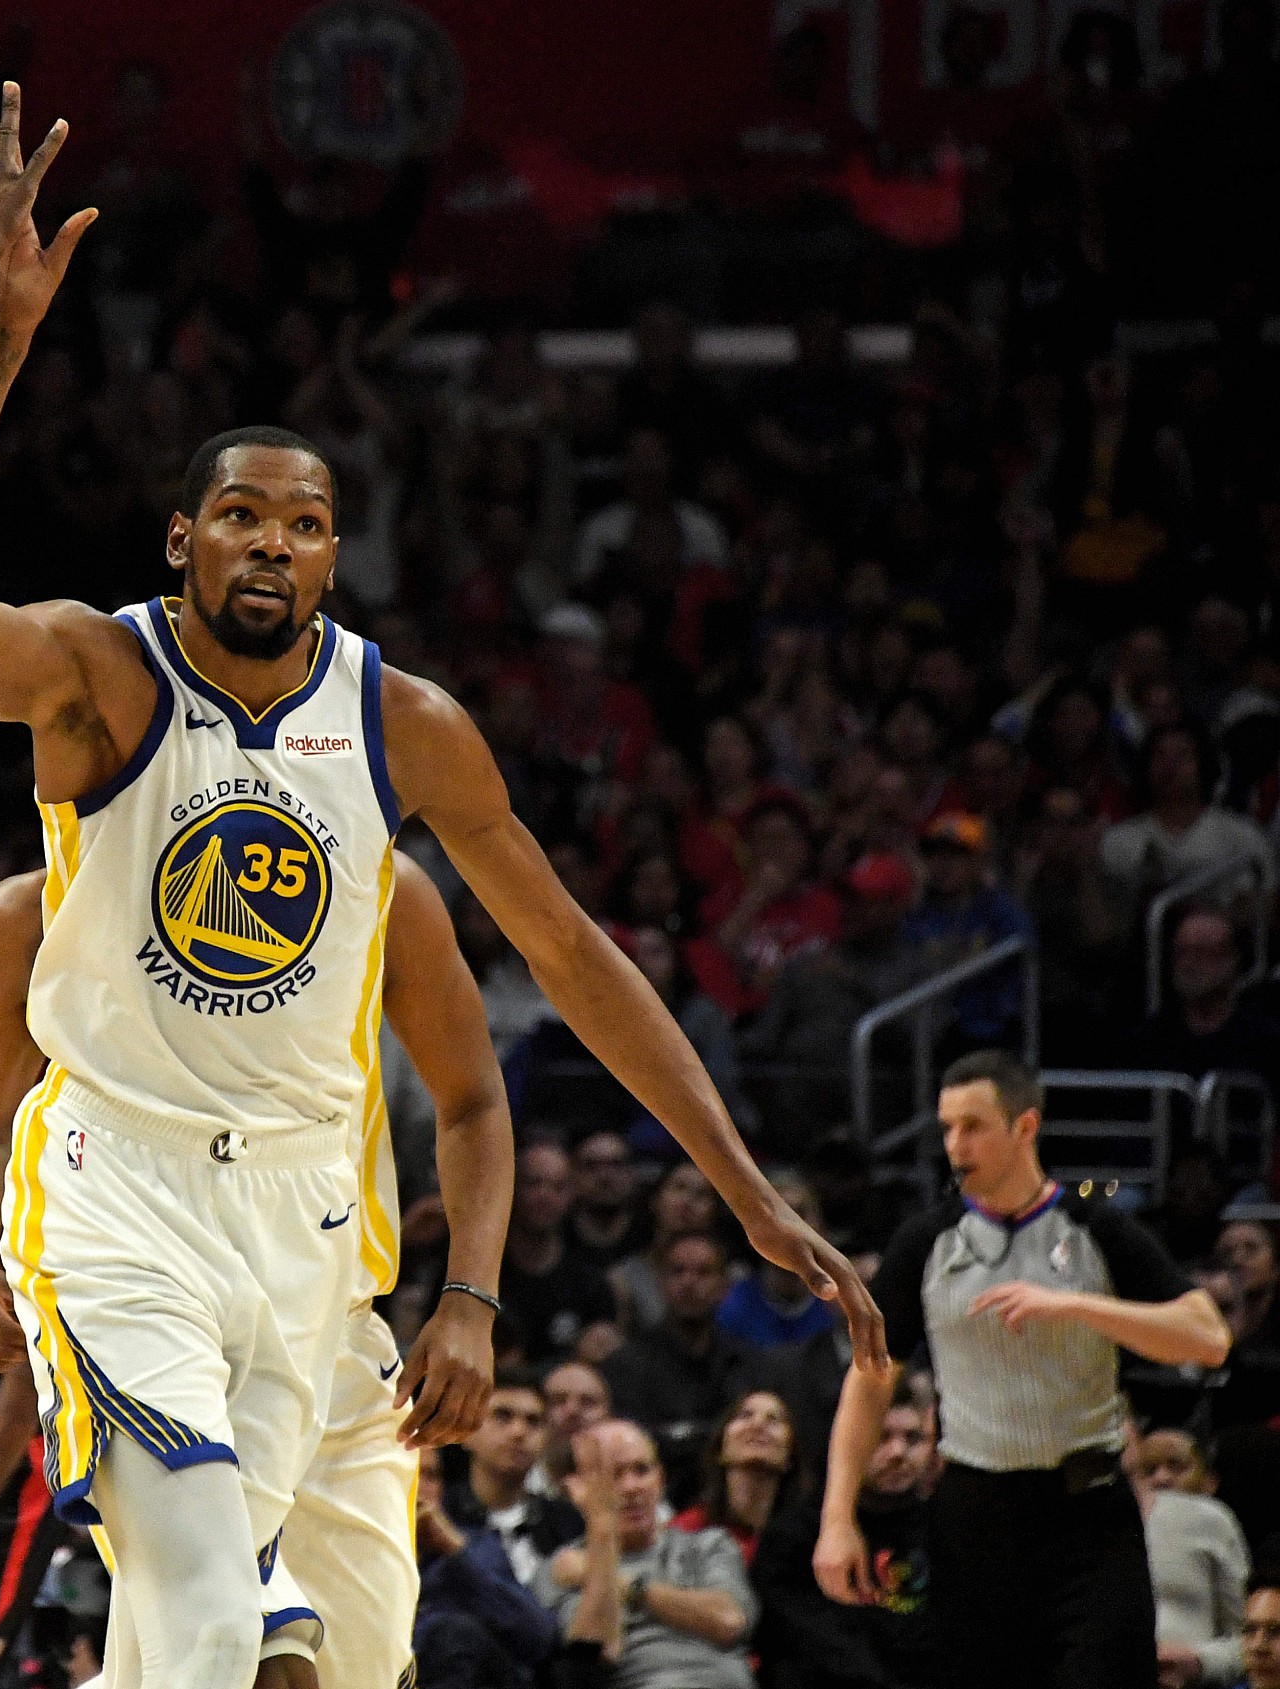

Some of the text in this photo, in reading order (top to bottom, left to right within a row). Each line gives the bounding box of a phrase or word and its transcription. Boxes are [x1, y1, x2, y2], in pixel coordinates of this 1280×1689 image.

[284, 734, 353, 751] Rakuten
[170, 778, 340, 854] GOLDEN STATE
[236, 842, 310, 898] 35
[136, 935, 317, 1017] WARRIORS
